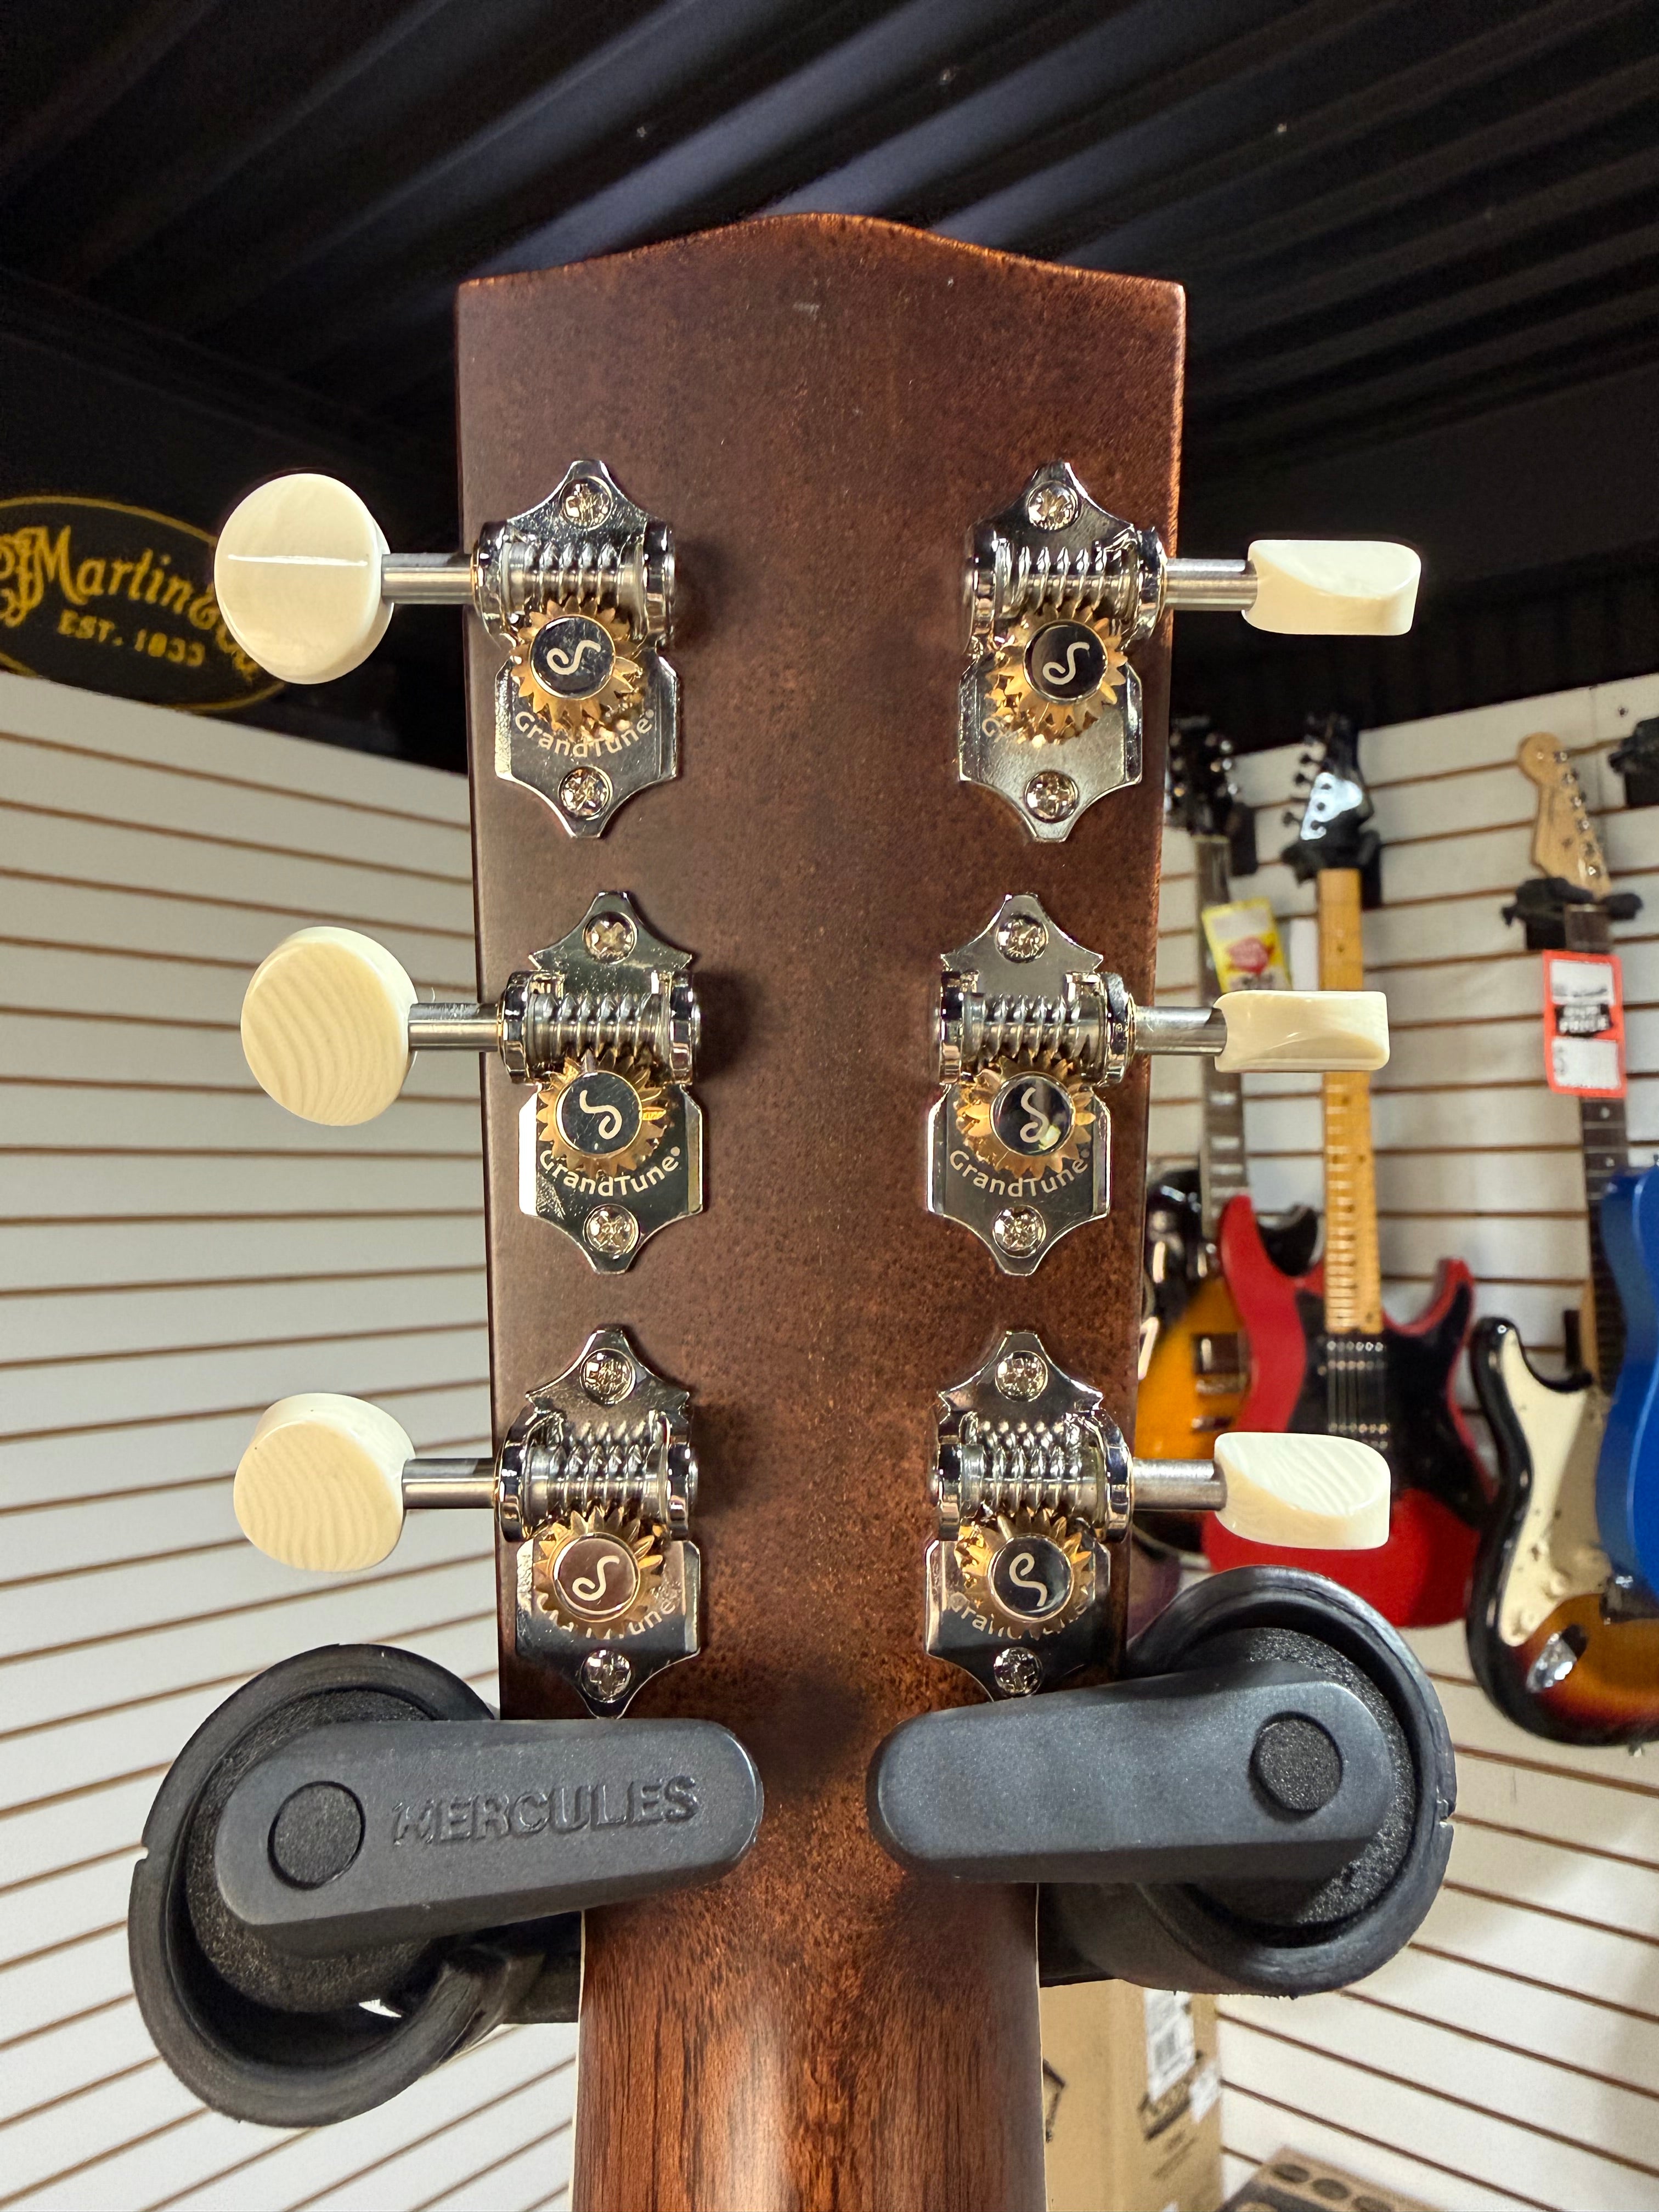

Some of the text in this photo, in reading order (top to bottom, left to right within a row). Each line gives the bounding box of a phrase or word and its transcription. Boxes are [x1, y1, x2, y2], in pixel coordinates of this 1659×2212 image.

[16, 524, 194, 616] Martin
[58, 609, 124, 646] EST.
[539, 1149, 680, 1197] GrandTune
[949, 1150, 1088, 1197] GrandTune
